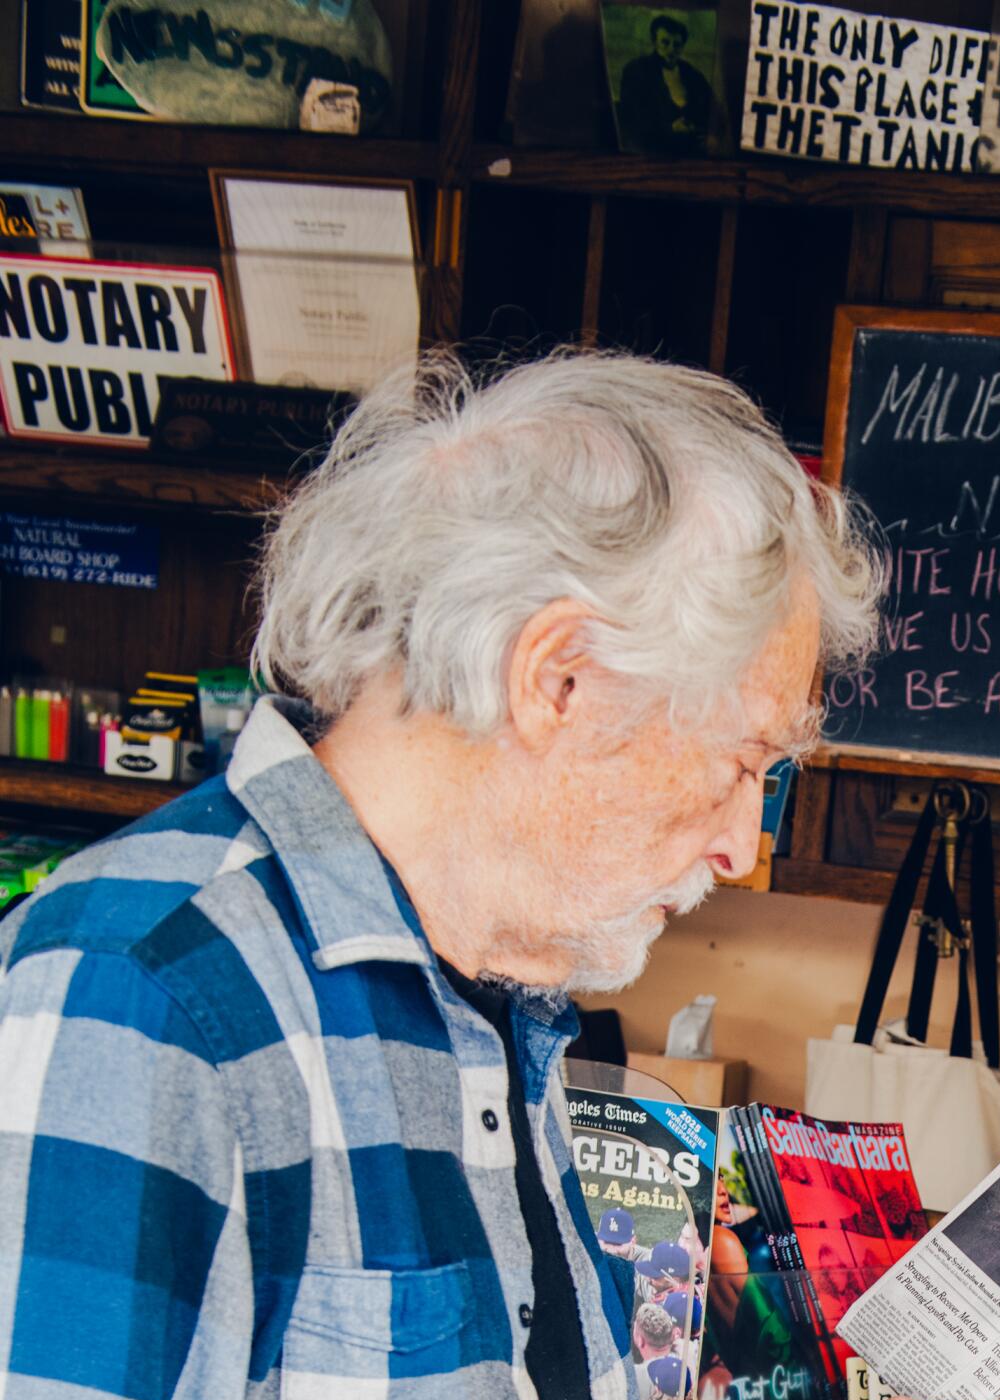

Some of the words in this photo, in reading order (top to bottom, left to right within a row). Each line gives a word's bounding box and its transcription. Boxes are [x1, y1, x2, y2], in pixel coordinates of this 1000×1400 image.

[754, 3, 820, 56] THE
[829, 16, 919, 68] ONLY
[754, 51, 846, 109] THIS
[854, 66, 958, 125] PLACE
[751, 101, 826, 158] THE
[832, 113, 996, 173] TITANIC
[0, 272, 207, 355] NOTARY
[12, 361, 170, 438] PUBL
[18, 545, 74, 565] BOARD
[77, 550, 121, 569] SHOP
[882, 546, 952, 597] ITE
[950, 611, 993, 658] US
[830, 667, 879, 709] OR
[906, 670, 962, 712] BE
[566, 1100, 601, 1117] geles
[604, 1103, 647, 1124] Times
[605, 1123, 626, 1132] ISSUE
[855, 1126, 901, 1136] MAGAZINE
[573, 1136, 700, 1188] GERS
[762, 1107, 827, 1162] Santa
[815, 1120, 910, 1172] Barbara
[603, 1180, 683, 1210] Again!
[900, 1276, 927, 1306] Planning
[923, 1299, 946, 1327] Layoffs
[943, 1320, 956, 1335] and
[953, 1328, 967, 1343] Pay
[964, 1339, 979, 1356] Cuts
[905, 1260, 934, 1292] Struggling
[937, 1291, 959, 1317] Recover,
[958, 1311, 971, 1325] Met
[969, 1321, 989, 1344] Opera
[973, 1367, 994, 1392] Before
[982, 1355, 1000, 1376] Allies
